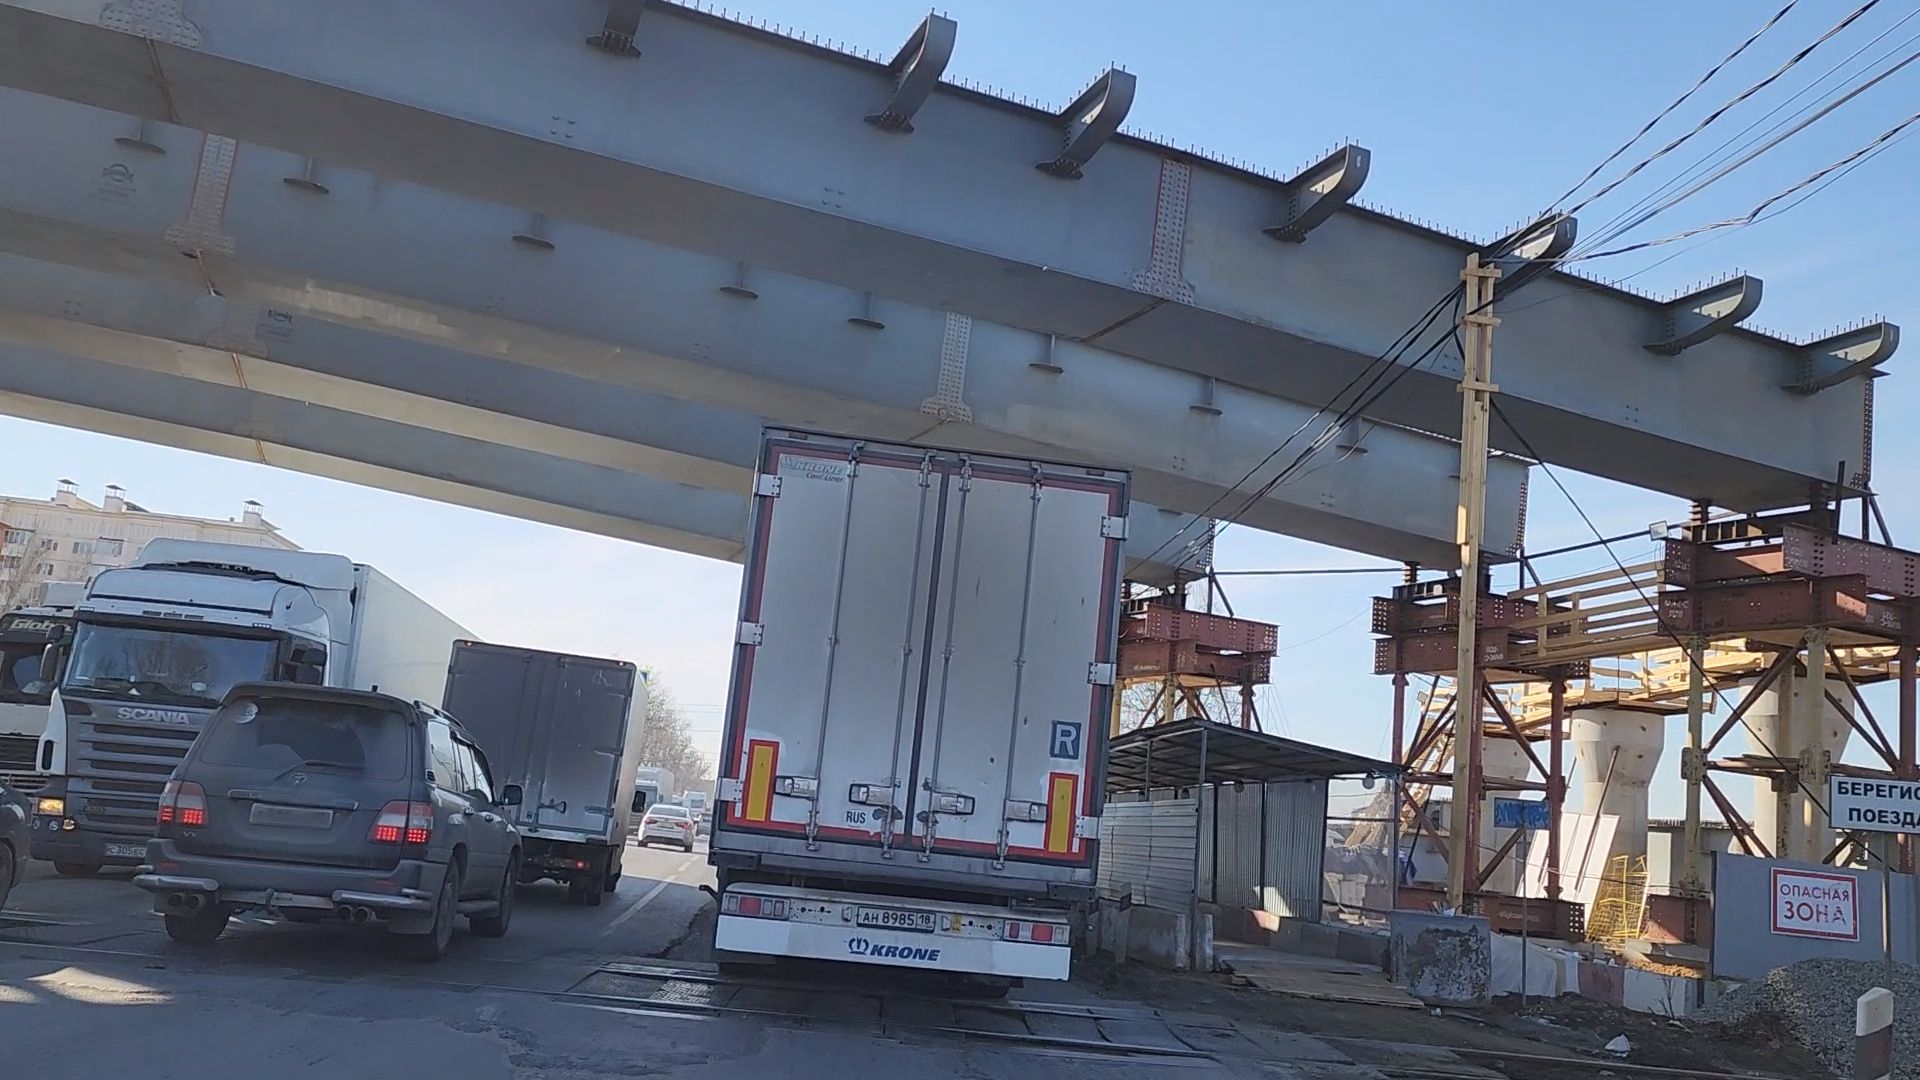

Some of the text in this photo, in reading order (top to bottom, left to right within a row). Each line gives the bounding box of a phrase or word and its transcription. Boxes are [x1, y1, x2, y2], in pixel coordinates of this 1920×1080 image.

[795, 461, 844, 475] KRONE
[118, 707, 190, 725] SCANIA
[1054, 724, 1076, 756] R
[846, 811, 866, 824] RUS
[1848, 807, 1920, 829] ПОЕЗД
[1780, 884, 1850, 902] ОПАСНАЯ
[1783, 900, 1847, 925] ЗОНА
[870, 944, 941, 962] KRONE
